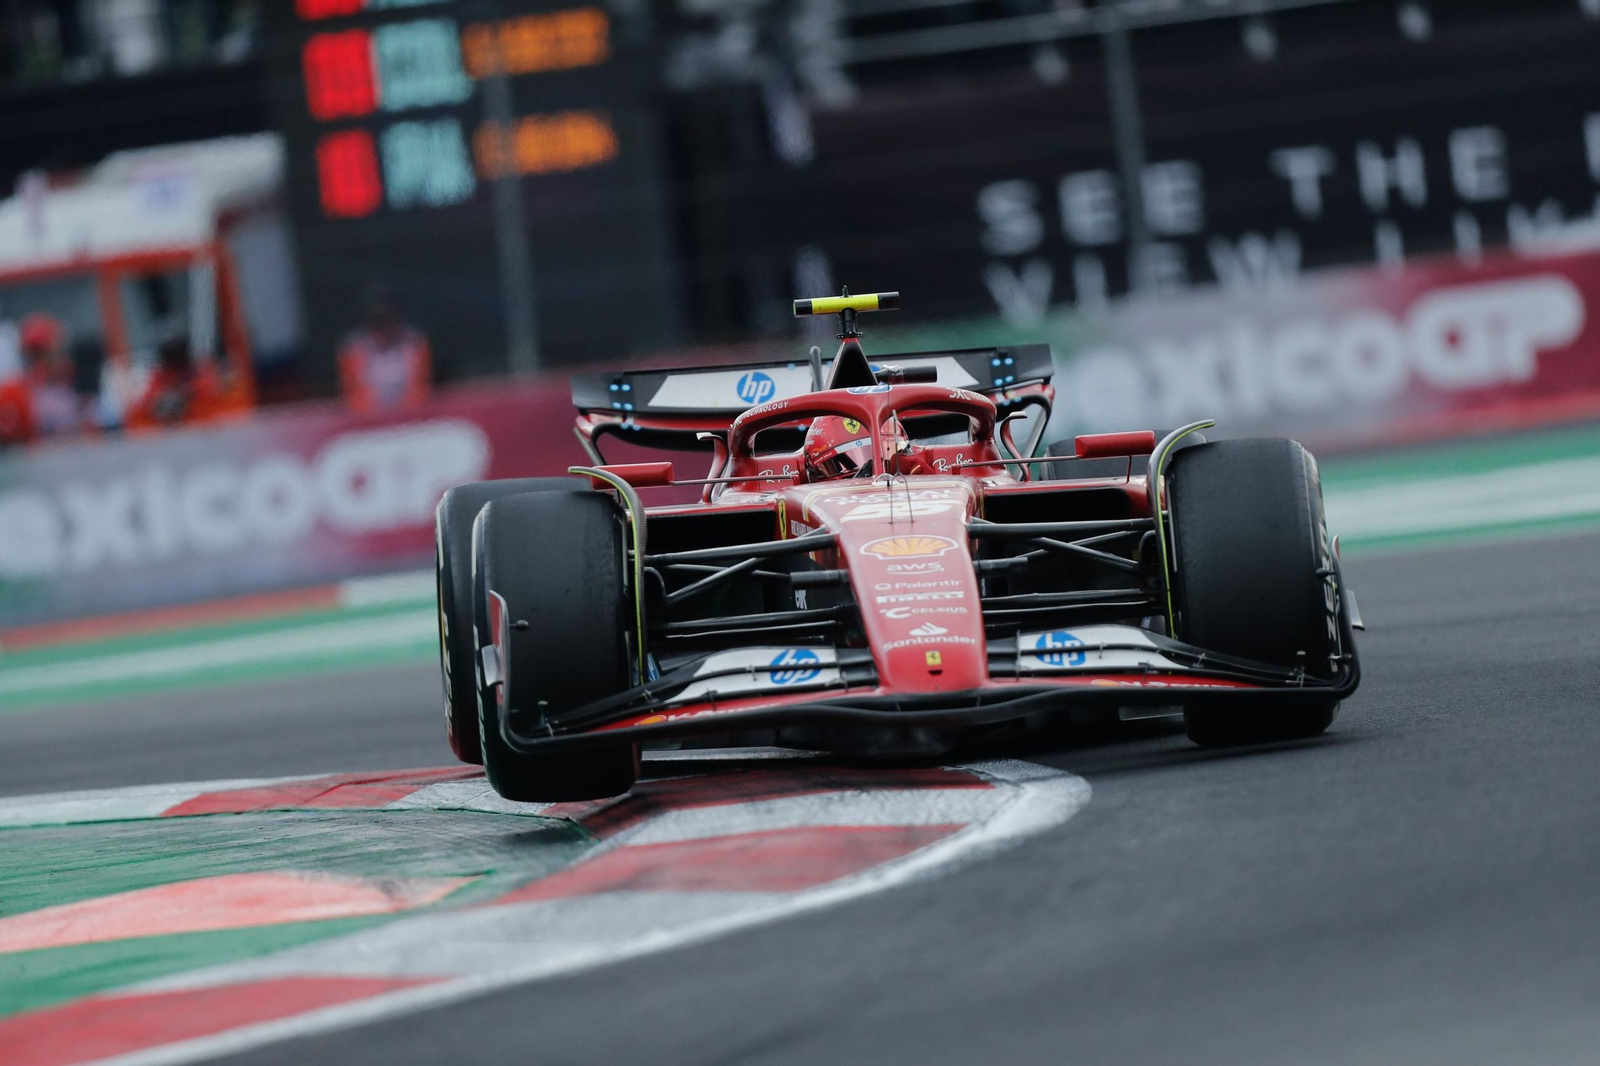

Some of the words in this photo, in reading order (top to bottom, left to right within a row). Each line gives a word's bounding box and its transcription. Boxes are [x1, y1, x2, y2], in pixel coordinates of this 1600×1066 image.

[977, 157, 1205, 257] SEE
[1267, 125, 1510, 220] THE
[740, 371, 773, 405] hp
[886, 562, 942, 572] aws
[895, 580, 963, 589] Palantir
[1049, 630, 1083, 666] hp
[771, 649, 819, 685] hp
